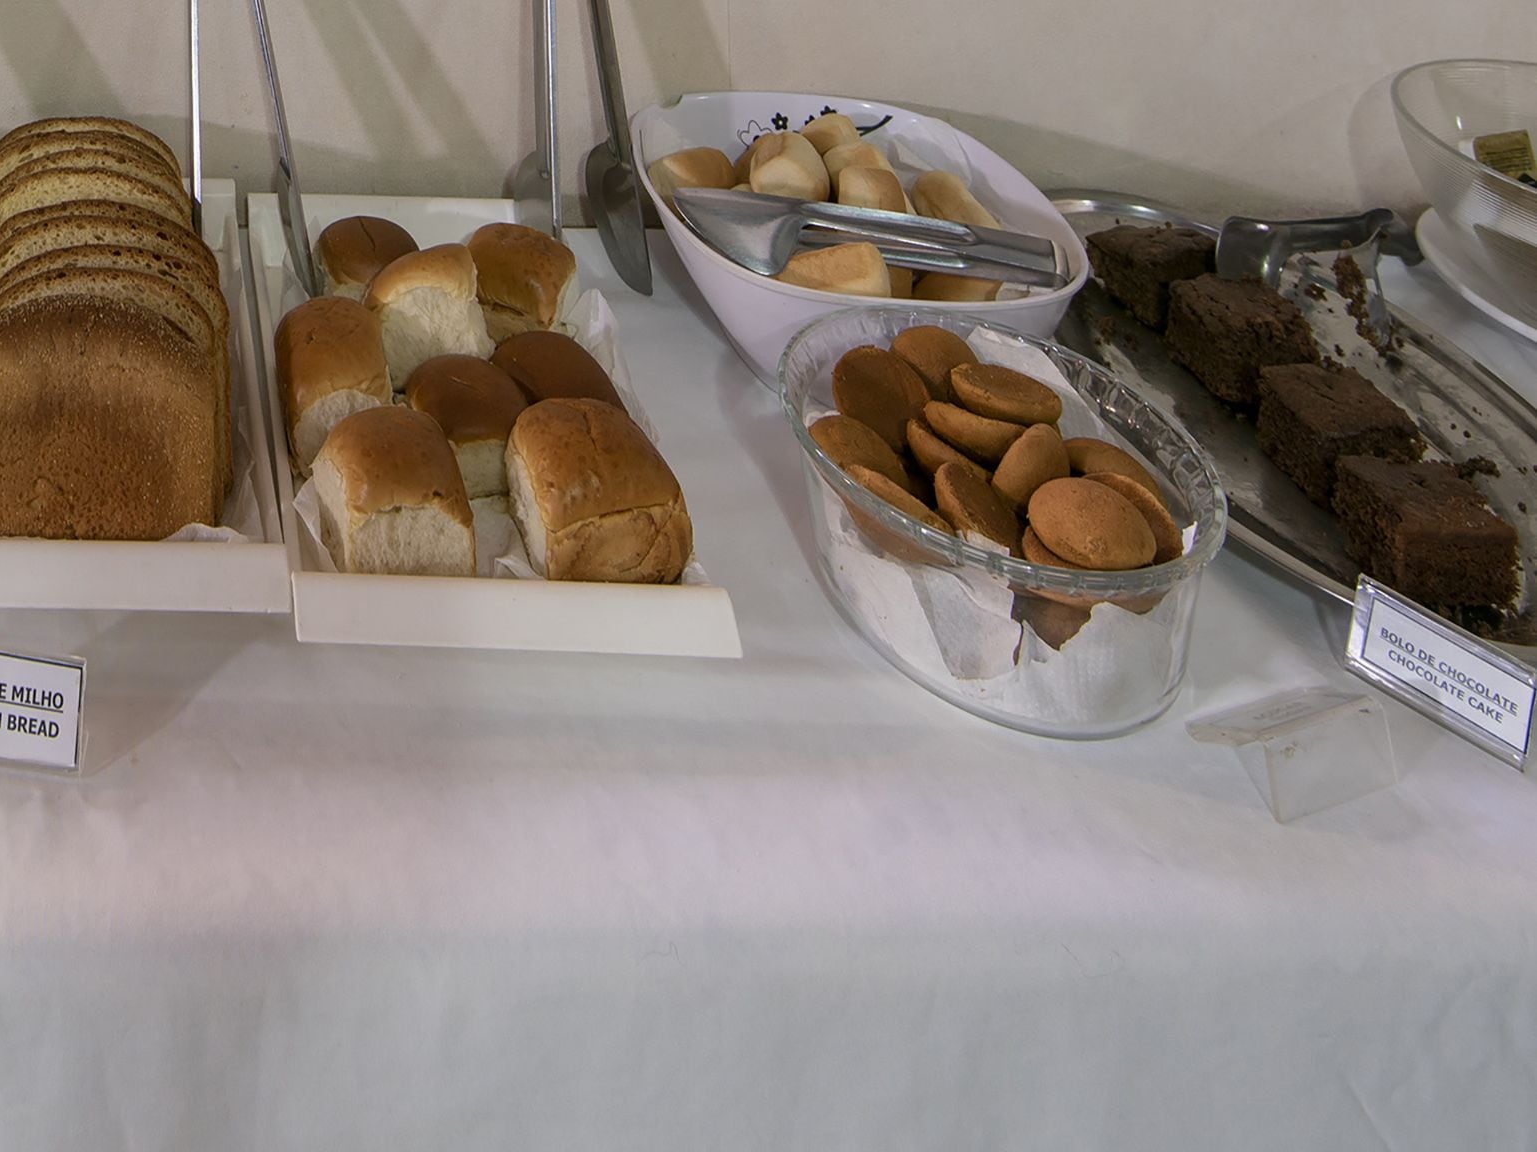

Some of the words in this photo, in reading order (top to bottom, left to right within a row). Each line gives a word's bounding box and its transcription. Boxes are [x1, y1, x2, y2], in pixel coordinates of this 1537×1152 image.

[1380, 627, 1415, 654] BOLO
[1418, 649, 1436, 666] DE
[1438, 661, 1518, 713] CHOCOLATE
[1388, 649, 1464, 700] CHOCOLATE
[1468, 696, 1503, 724] CAKE
[11, 685, 64, 709] MILHO
[7, 714, 59, 738] BREAD
